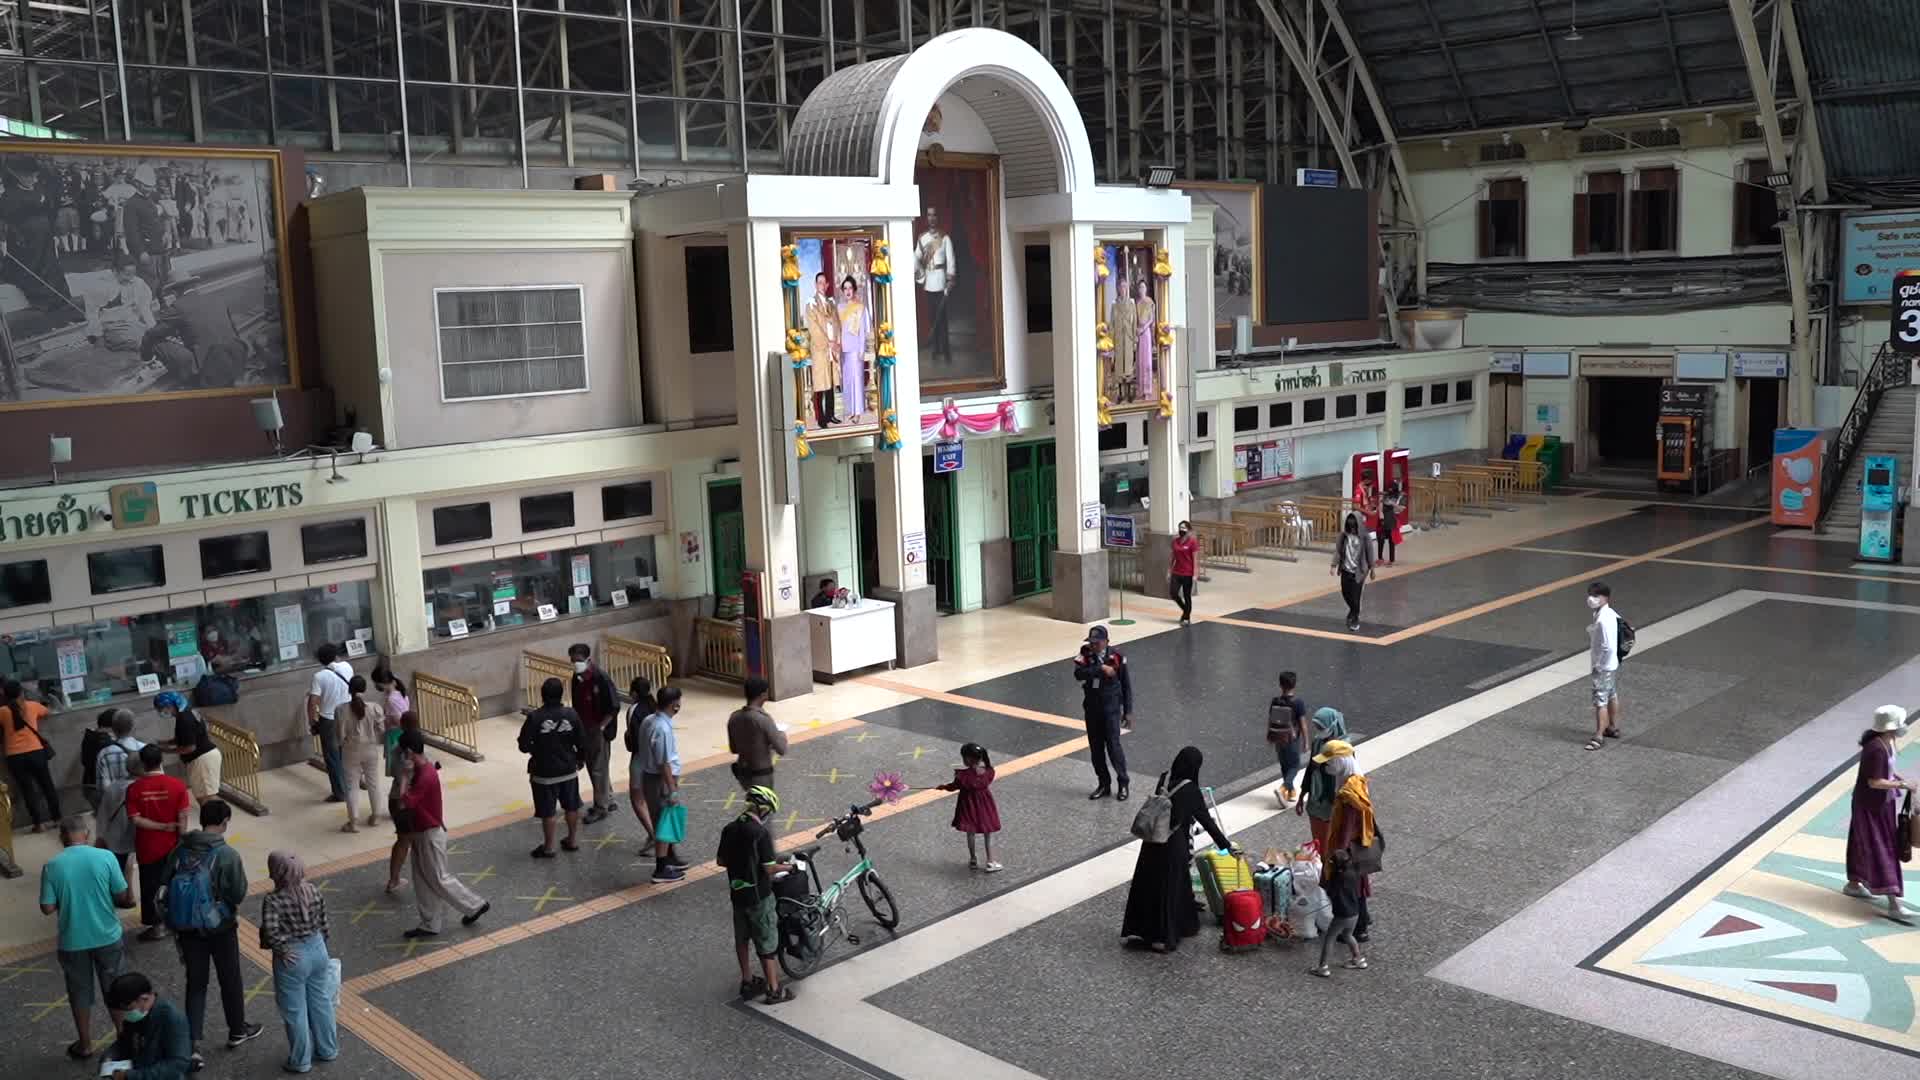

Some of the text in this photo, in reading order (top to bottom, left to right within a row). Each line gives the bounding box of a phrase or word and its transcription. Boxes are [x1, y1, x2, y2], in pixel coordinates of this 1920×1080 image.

[1662, 390, 1671, 402] 3
[179, 482, 304, 519] TICKETS
[1111, 529, 1126, 537] EXIT
